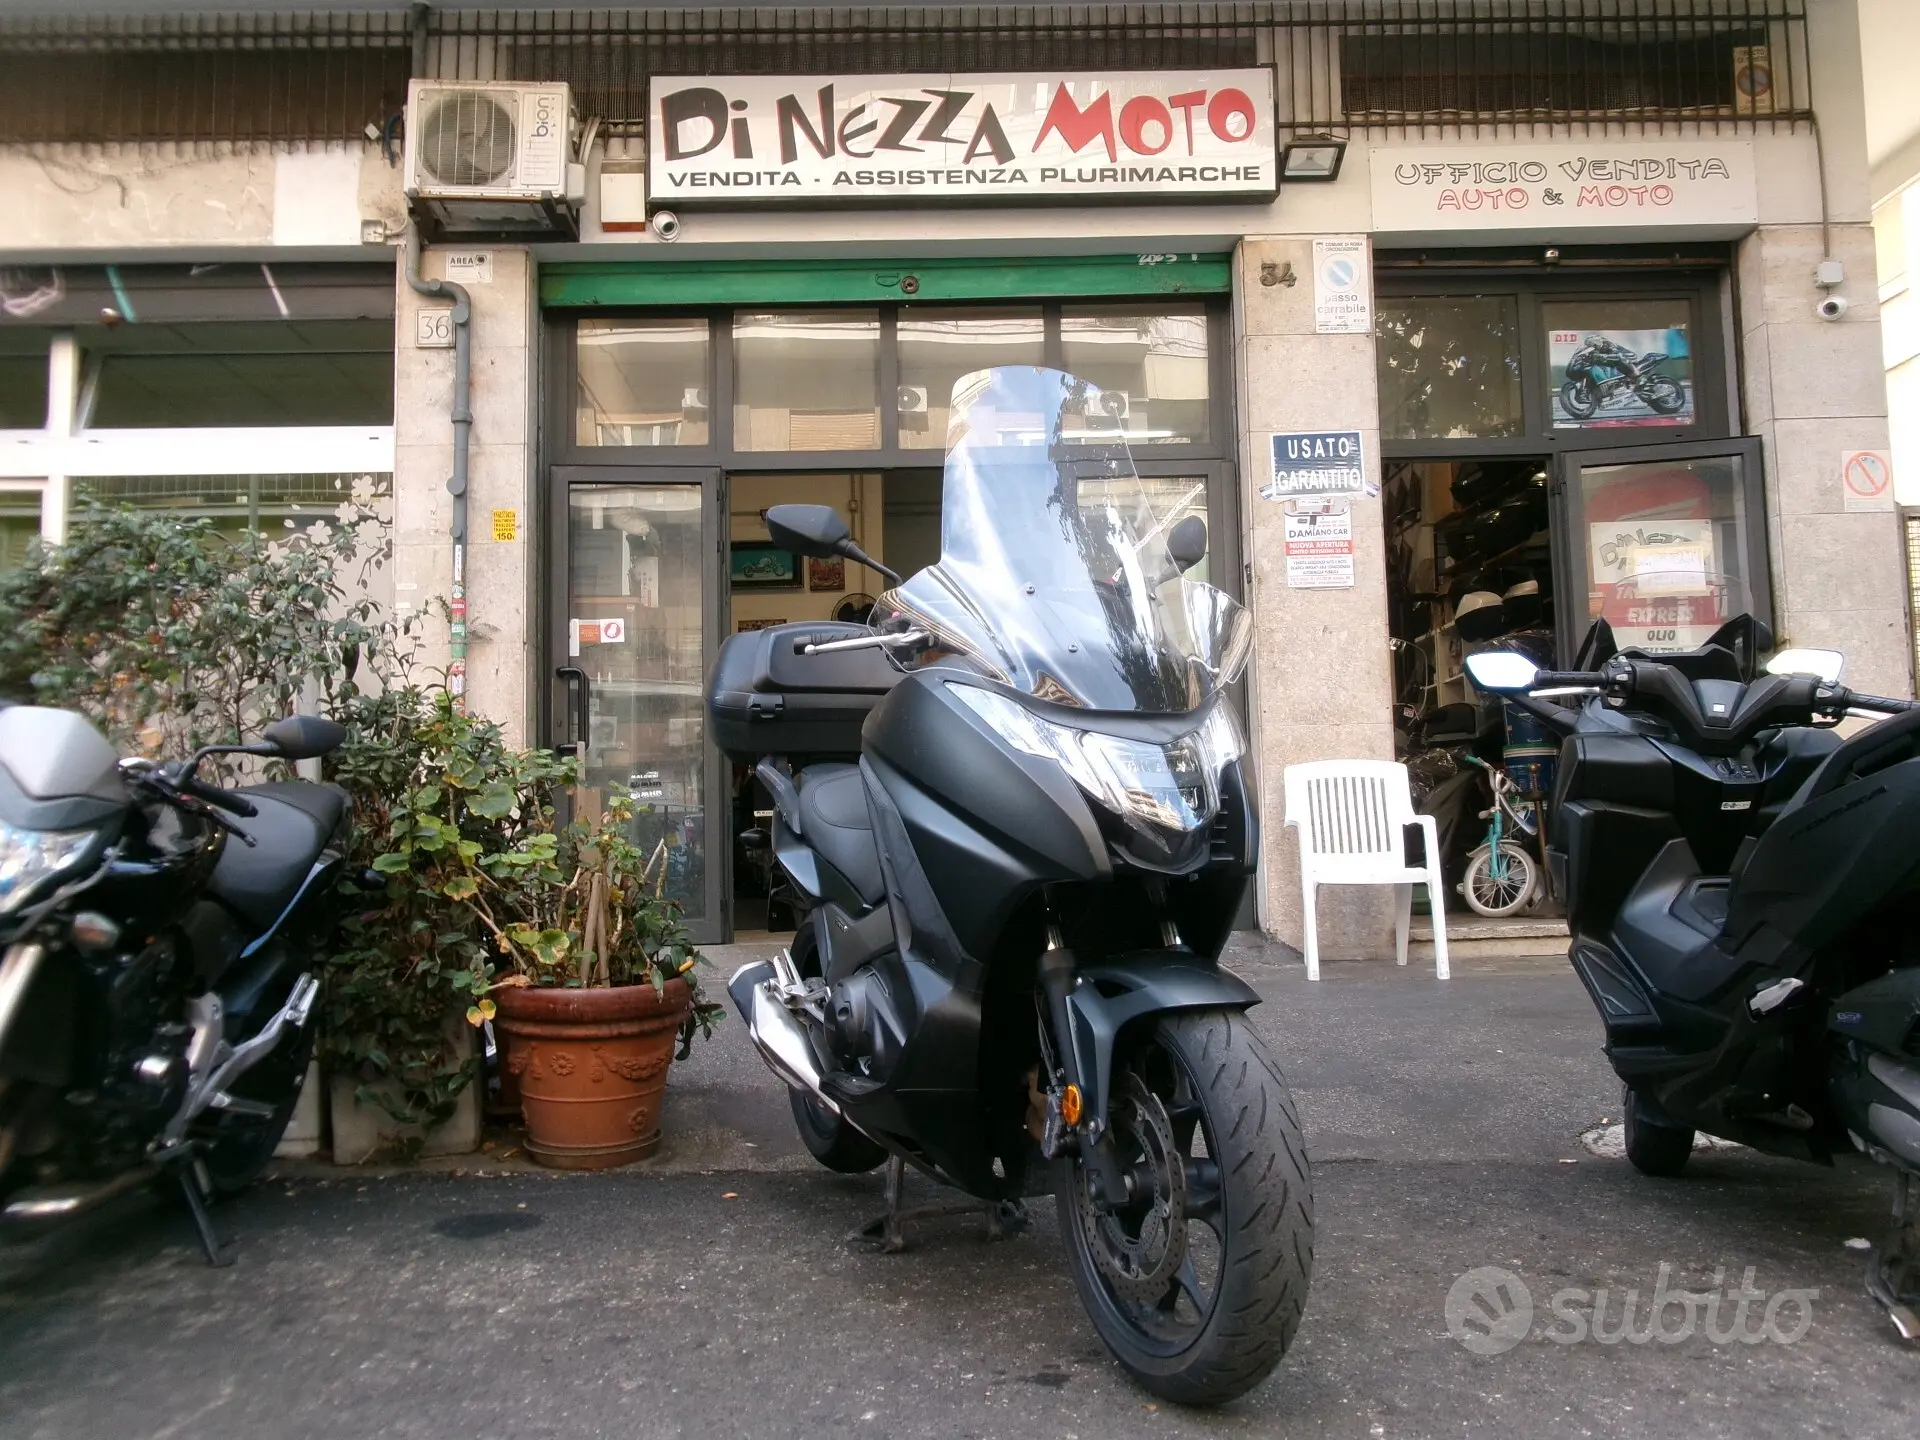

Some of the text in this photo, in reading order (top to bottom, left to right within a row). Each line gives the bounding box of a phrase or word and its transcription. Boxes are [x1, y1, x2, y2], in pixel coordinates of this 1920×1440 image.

[1031, 80, 1256, 163] MOTO
[667, 171, 802, 187] VENDITA
[832, 169, 1028, 186] ASSISTENZA
[1041, 166, 1260, 183] PLURIMARCHE
[1395, 157, 1730, 185] UFFICIO VENDITA
[1437, 184, 1674, 210] AUTO & MOTO
[450, 257, 474, 265] AREA
[1259, 262, 1297, 287] 34
[1317, 304, 1366, 314] carrabile
[1325, 294, 1358, 304] passo
[420, 315, 449, 339] 36
[1287, 437, 1350, 459] USATO
[1277, 468, 1361, 491] GARANTITO
[1289, 529, 1332, 538] DAMIANO
[1647, 629, 1676, 641] OLIO
